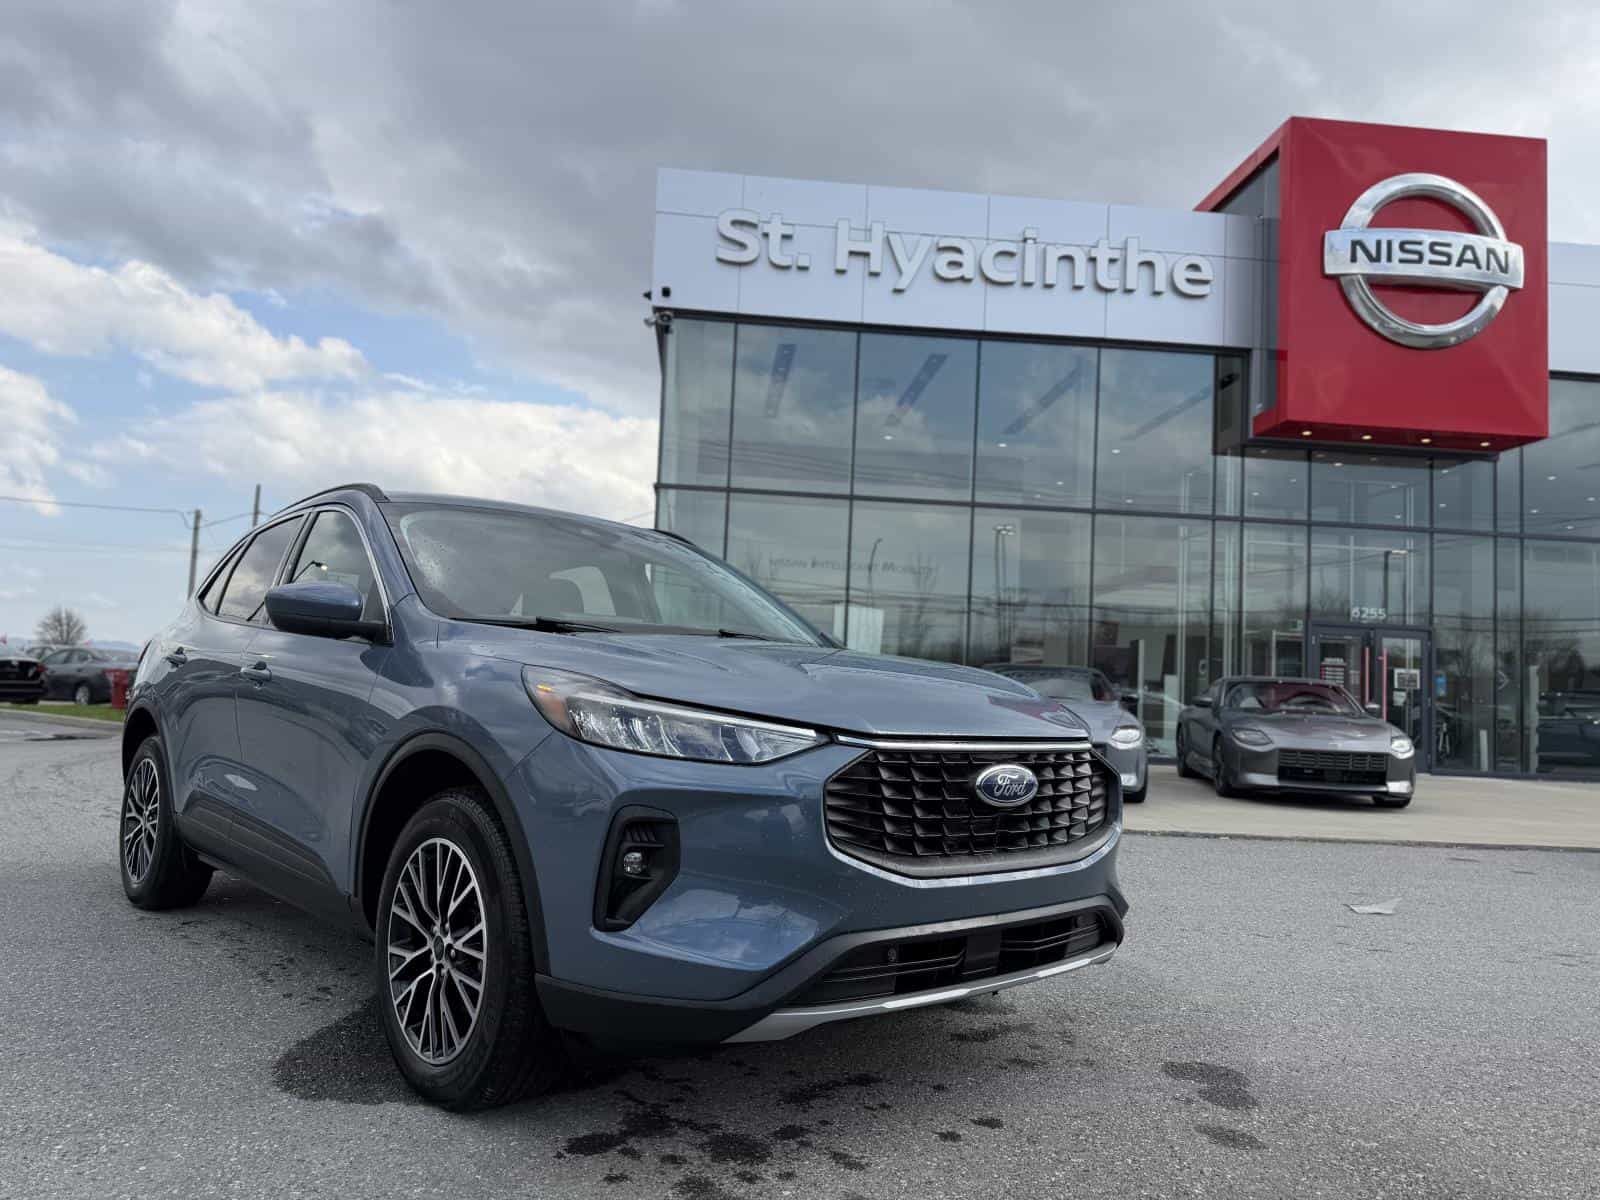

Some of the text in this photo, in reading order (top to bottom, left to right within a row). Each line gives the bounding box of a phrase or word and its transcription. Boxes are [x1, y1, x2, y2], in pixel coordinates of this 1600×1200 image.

[716, 208, 1214, 297] St. Hyacinthe
[1350, 239, 1509, 274] NISSAN
[1351, 607, 1386, 619] 6255
[993, 773, 1027, 797] Ford
